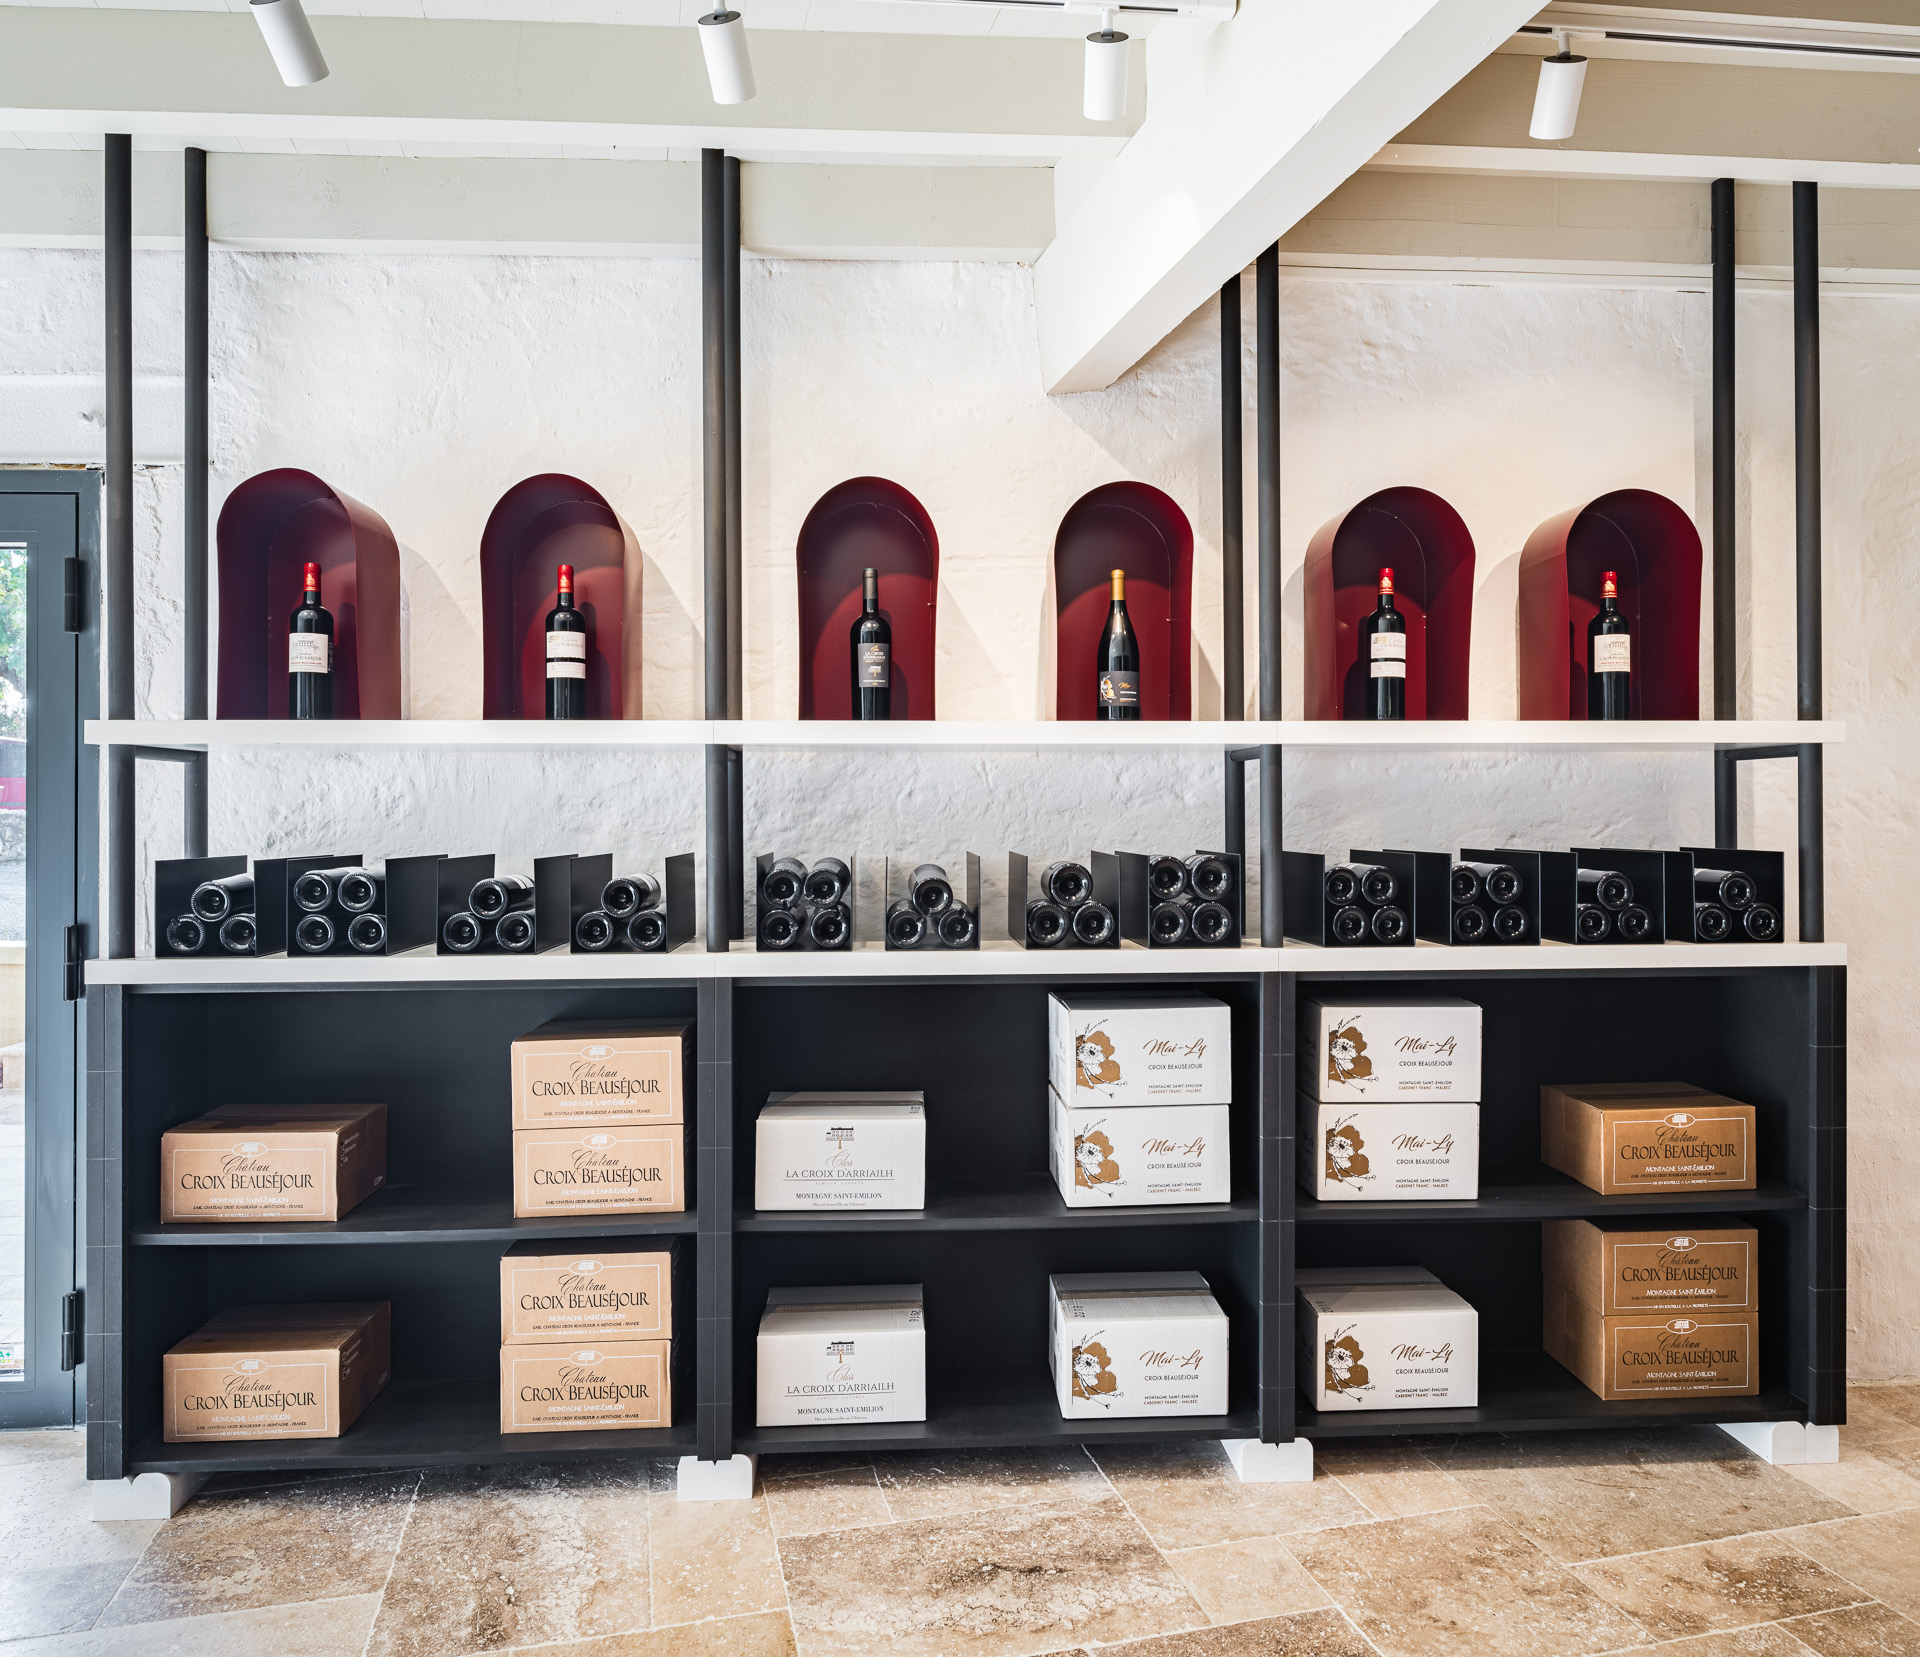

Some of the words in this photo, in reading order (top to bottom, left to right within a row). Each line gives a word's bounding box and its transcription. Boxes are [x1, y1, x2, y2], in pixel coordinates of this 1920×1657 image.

[1143, 1038, 1207, 1059] Mai-Ly
[1394, 1036, 1457, 1056] Mai-Ly
[570, 1061, 618, 1081] Château
[532, 1080, 575, 1096] CROIX
[580, 1078, 661, 1098] BEAUSÉJOUR
[1392, 1134, 1454, 1154] Mai-Ly
[1655, 1126, 1698, 1146] Château
[1142, 1137, 1206, 1158] Mai-Ly
[1621, 1145, 1660, 1159] CROIX
[1665, 1142, 1737, 1162] BEAUSÉJOUR
[220, 1154, 270, 1174] Château
[572, 1150, 619, 1170] Château
[826, 1150, 853, 1168] Clos
[181, 1174, 225, 1190] CROIX
[231, 1172, 314, 1193] BEAUSÉJOUR
[534, 1169, 577, 1185] CROIX
[582, 1166, 662, 1187] BEAUSÉJOUR
[786, 1170, 798, 1178] LA
[802, 1170, 833, 1178] CROIX
[1657, 1249, 1700, 1268] Château
[558, 1274, 606, 1294] Château
[1622, 1267, 1661, 1282] CROIX
[1666, 1265, 1739, 1284] BEAUSÉJOUR
[521, 1295, 563, 1310] CROIX
[569, 1291, 650, 1311] BEAUSÉJOUR
[1657, 1332, 1701, 1351] Château
[1140, 1349, 1204, 1370] Mai-Ly
[1391, 1342, 1453, 1363] Mai-Ly
[1622, 1351, 1662, 1365] CROIX
[1666, 1348, 1739, 1368] BEAUSÉJOUR
[559, 1366, 606, 1387] Château
[827, 1364, 854, 1382] Clos
[223, 1375, 272, 1396] Château
[521, 1386, 563, 1401] CROIX
[569, 1383, 649, 1403] BEAUSÉJOUR
[787, 1386, 800, 1394] LA
[803, 1384, 835, 1393] CROIX
[184, 1395, 228, 1410] CROIX
[234, 1391, 317, 1411] BEAUSÉJOUR
